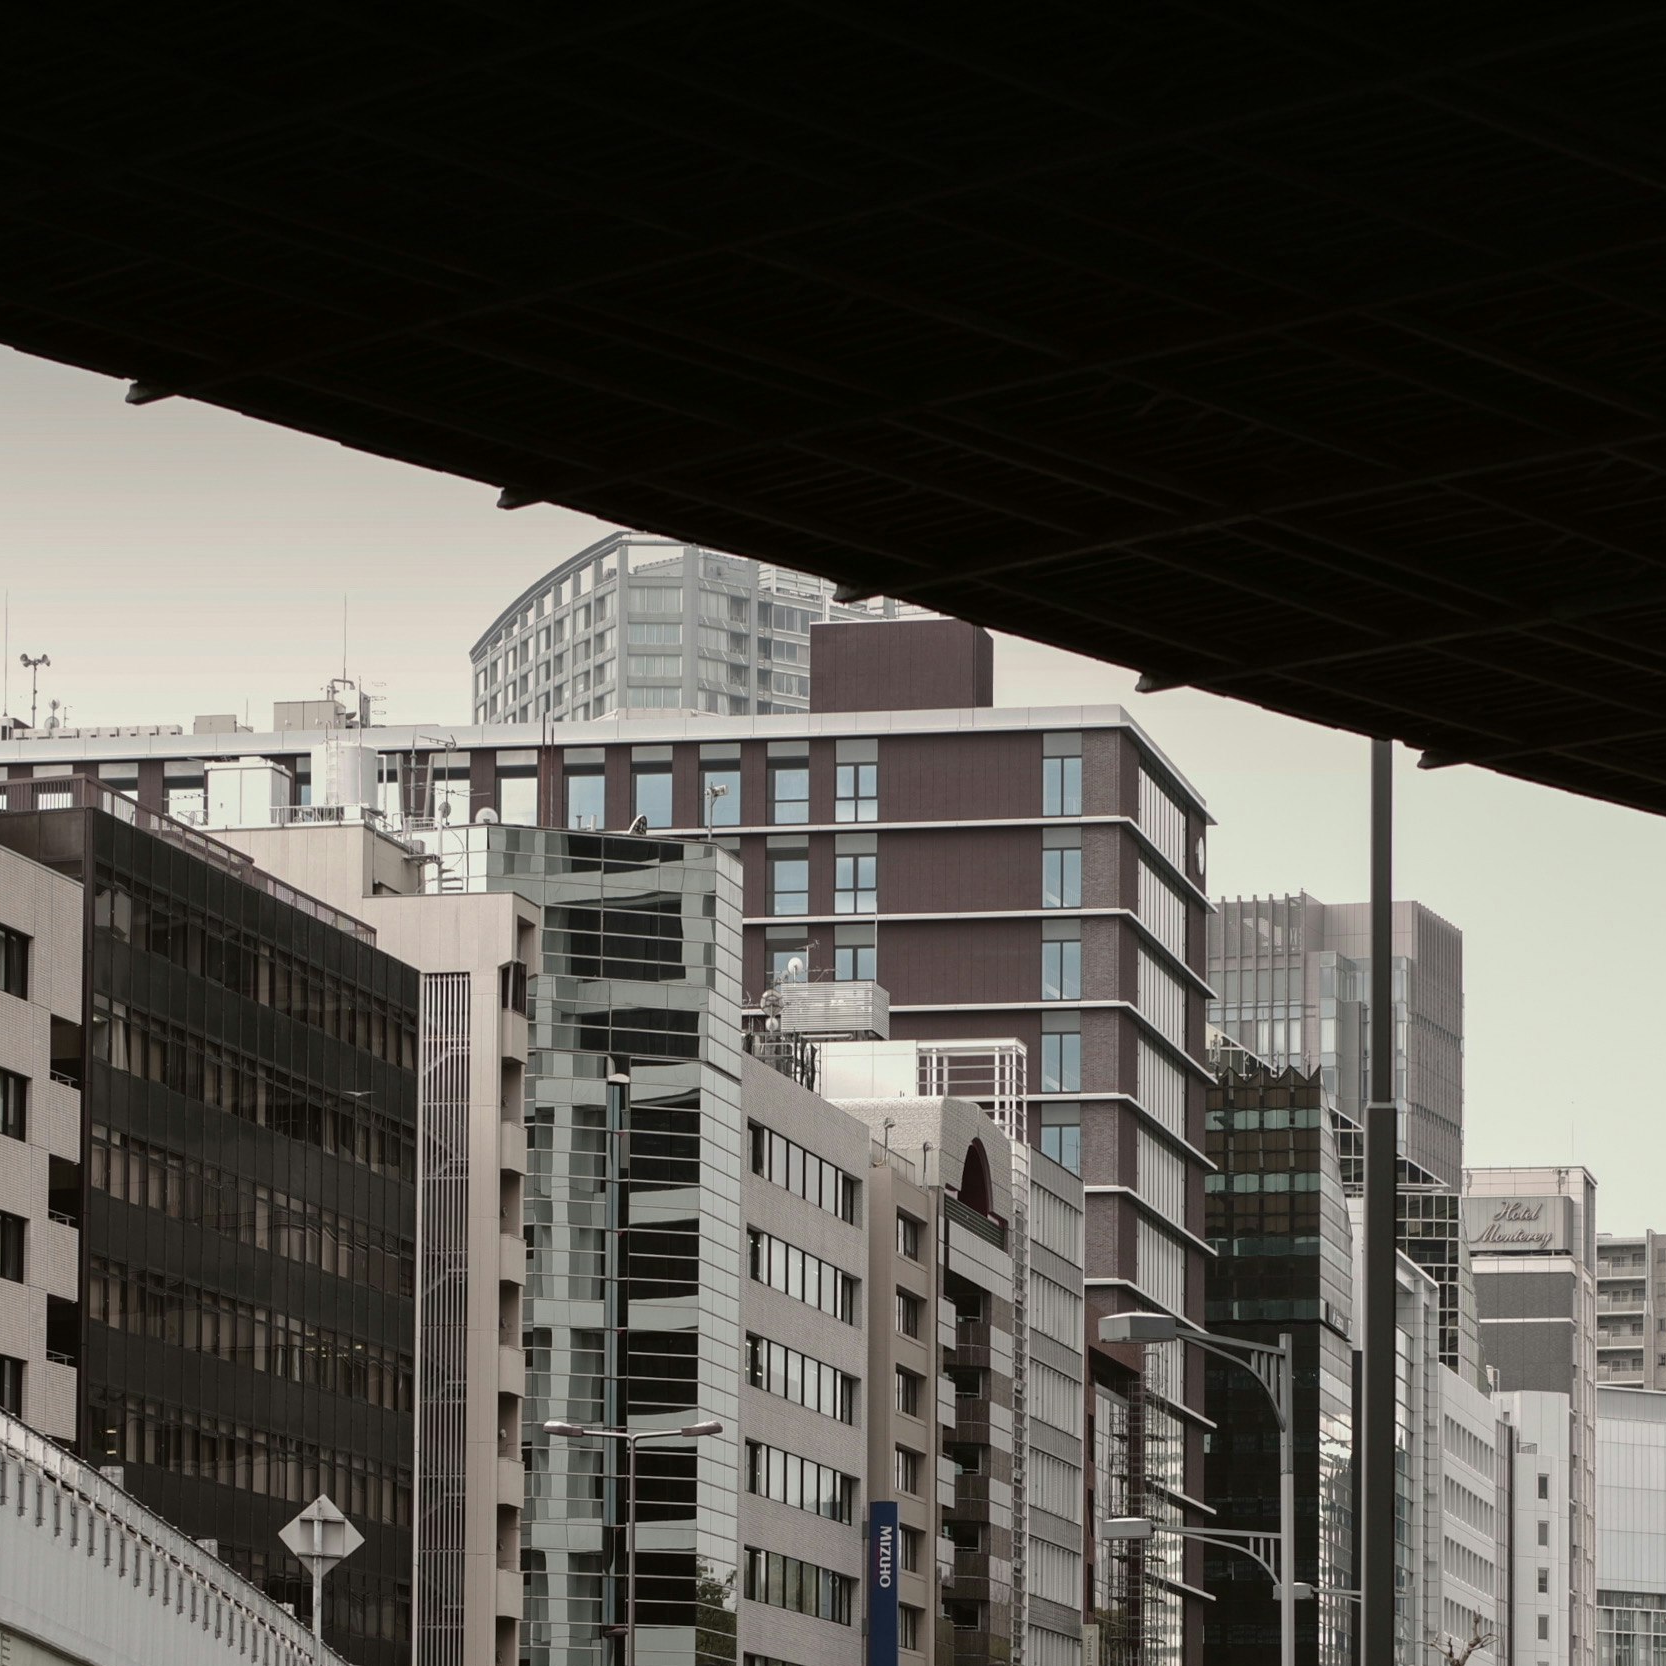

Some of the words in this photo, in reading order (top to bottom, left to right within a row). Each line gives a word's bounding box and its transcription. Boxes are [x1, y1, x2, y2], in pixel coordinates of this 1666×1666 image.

[1493, 1201, 1543, 1221] Hotel
[1468, 1223, 1553, 1249] Monterey
[879, 1525, 892, 1588] MIZUHO
